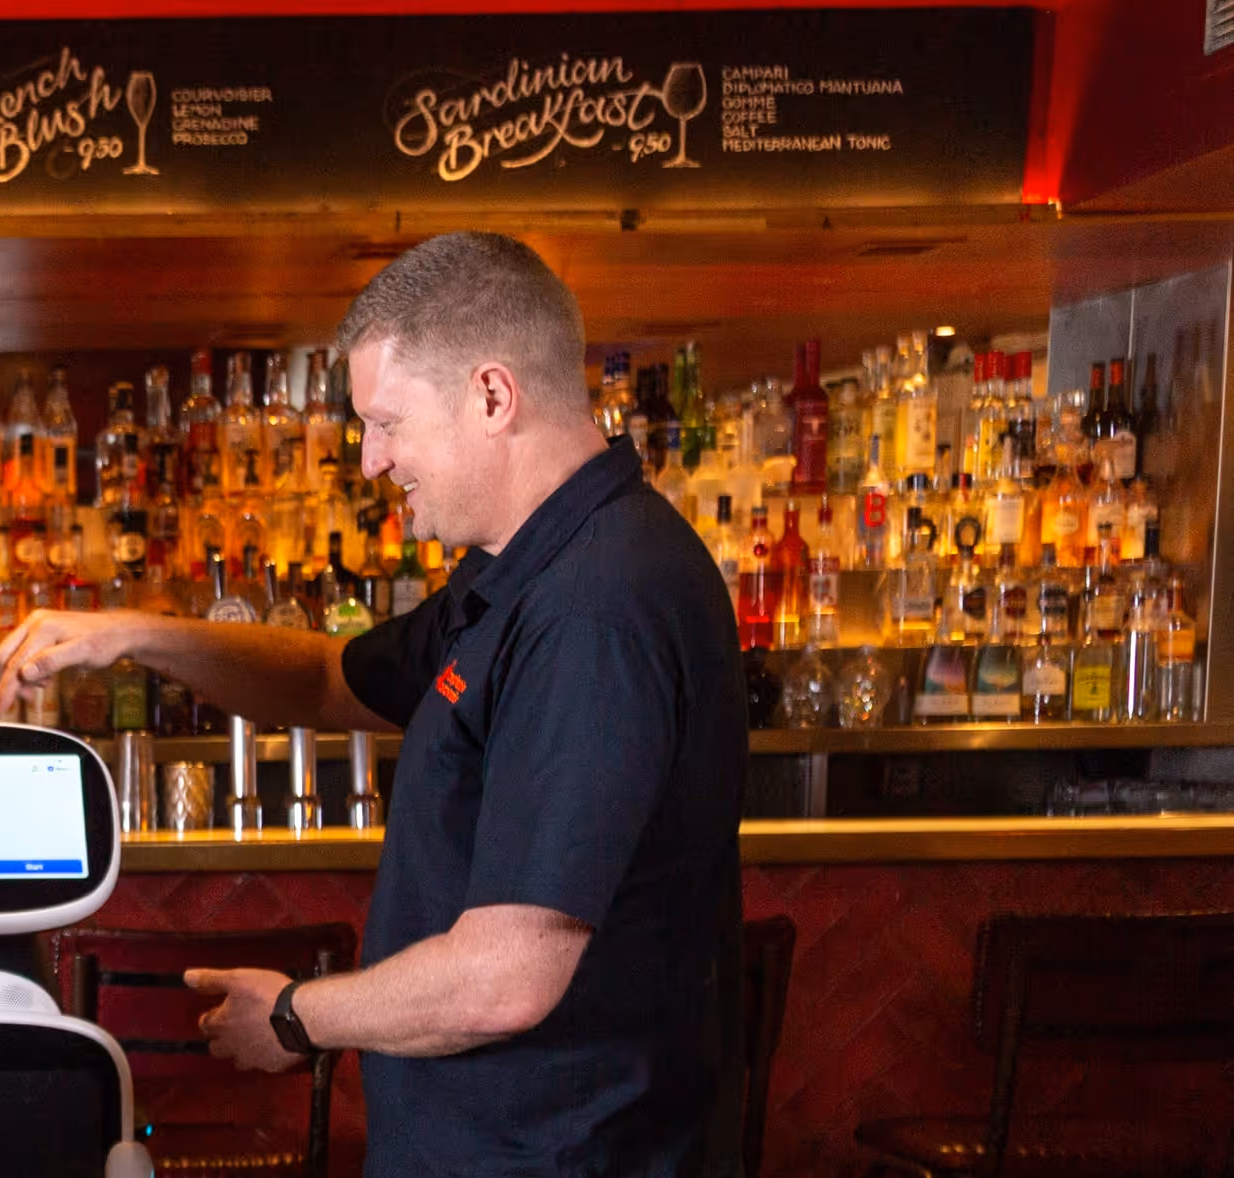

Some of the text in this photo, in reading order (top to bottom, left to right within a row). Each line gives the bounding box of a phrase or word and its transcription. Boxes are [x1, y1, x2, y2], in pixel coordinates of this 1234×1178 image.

[721, 66, 789, 81] CAMPARI
[721, 79, 904, 96] DIPLOMATICO MANTUANA
[172, 102, 223, 117] LEMON
[395, 52, 633, 157] Sardinian
[172, 116, 259, 131] GRENADINE
[721, 111, 777, 125] COFFEE
[172, 131, 248, 145] PROSECCO
[438, 82, 664, 181] Breakfast
[721, 123, 758, 138] SALT
[722, 133, 892, 152] MEDITERRANEAN TONIC
